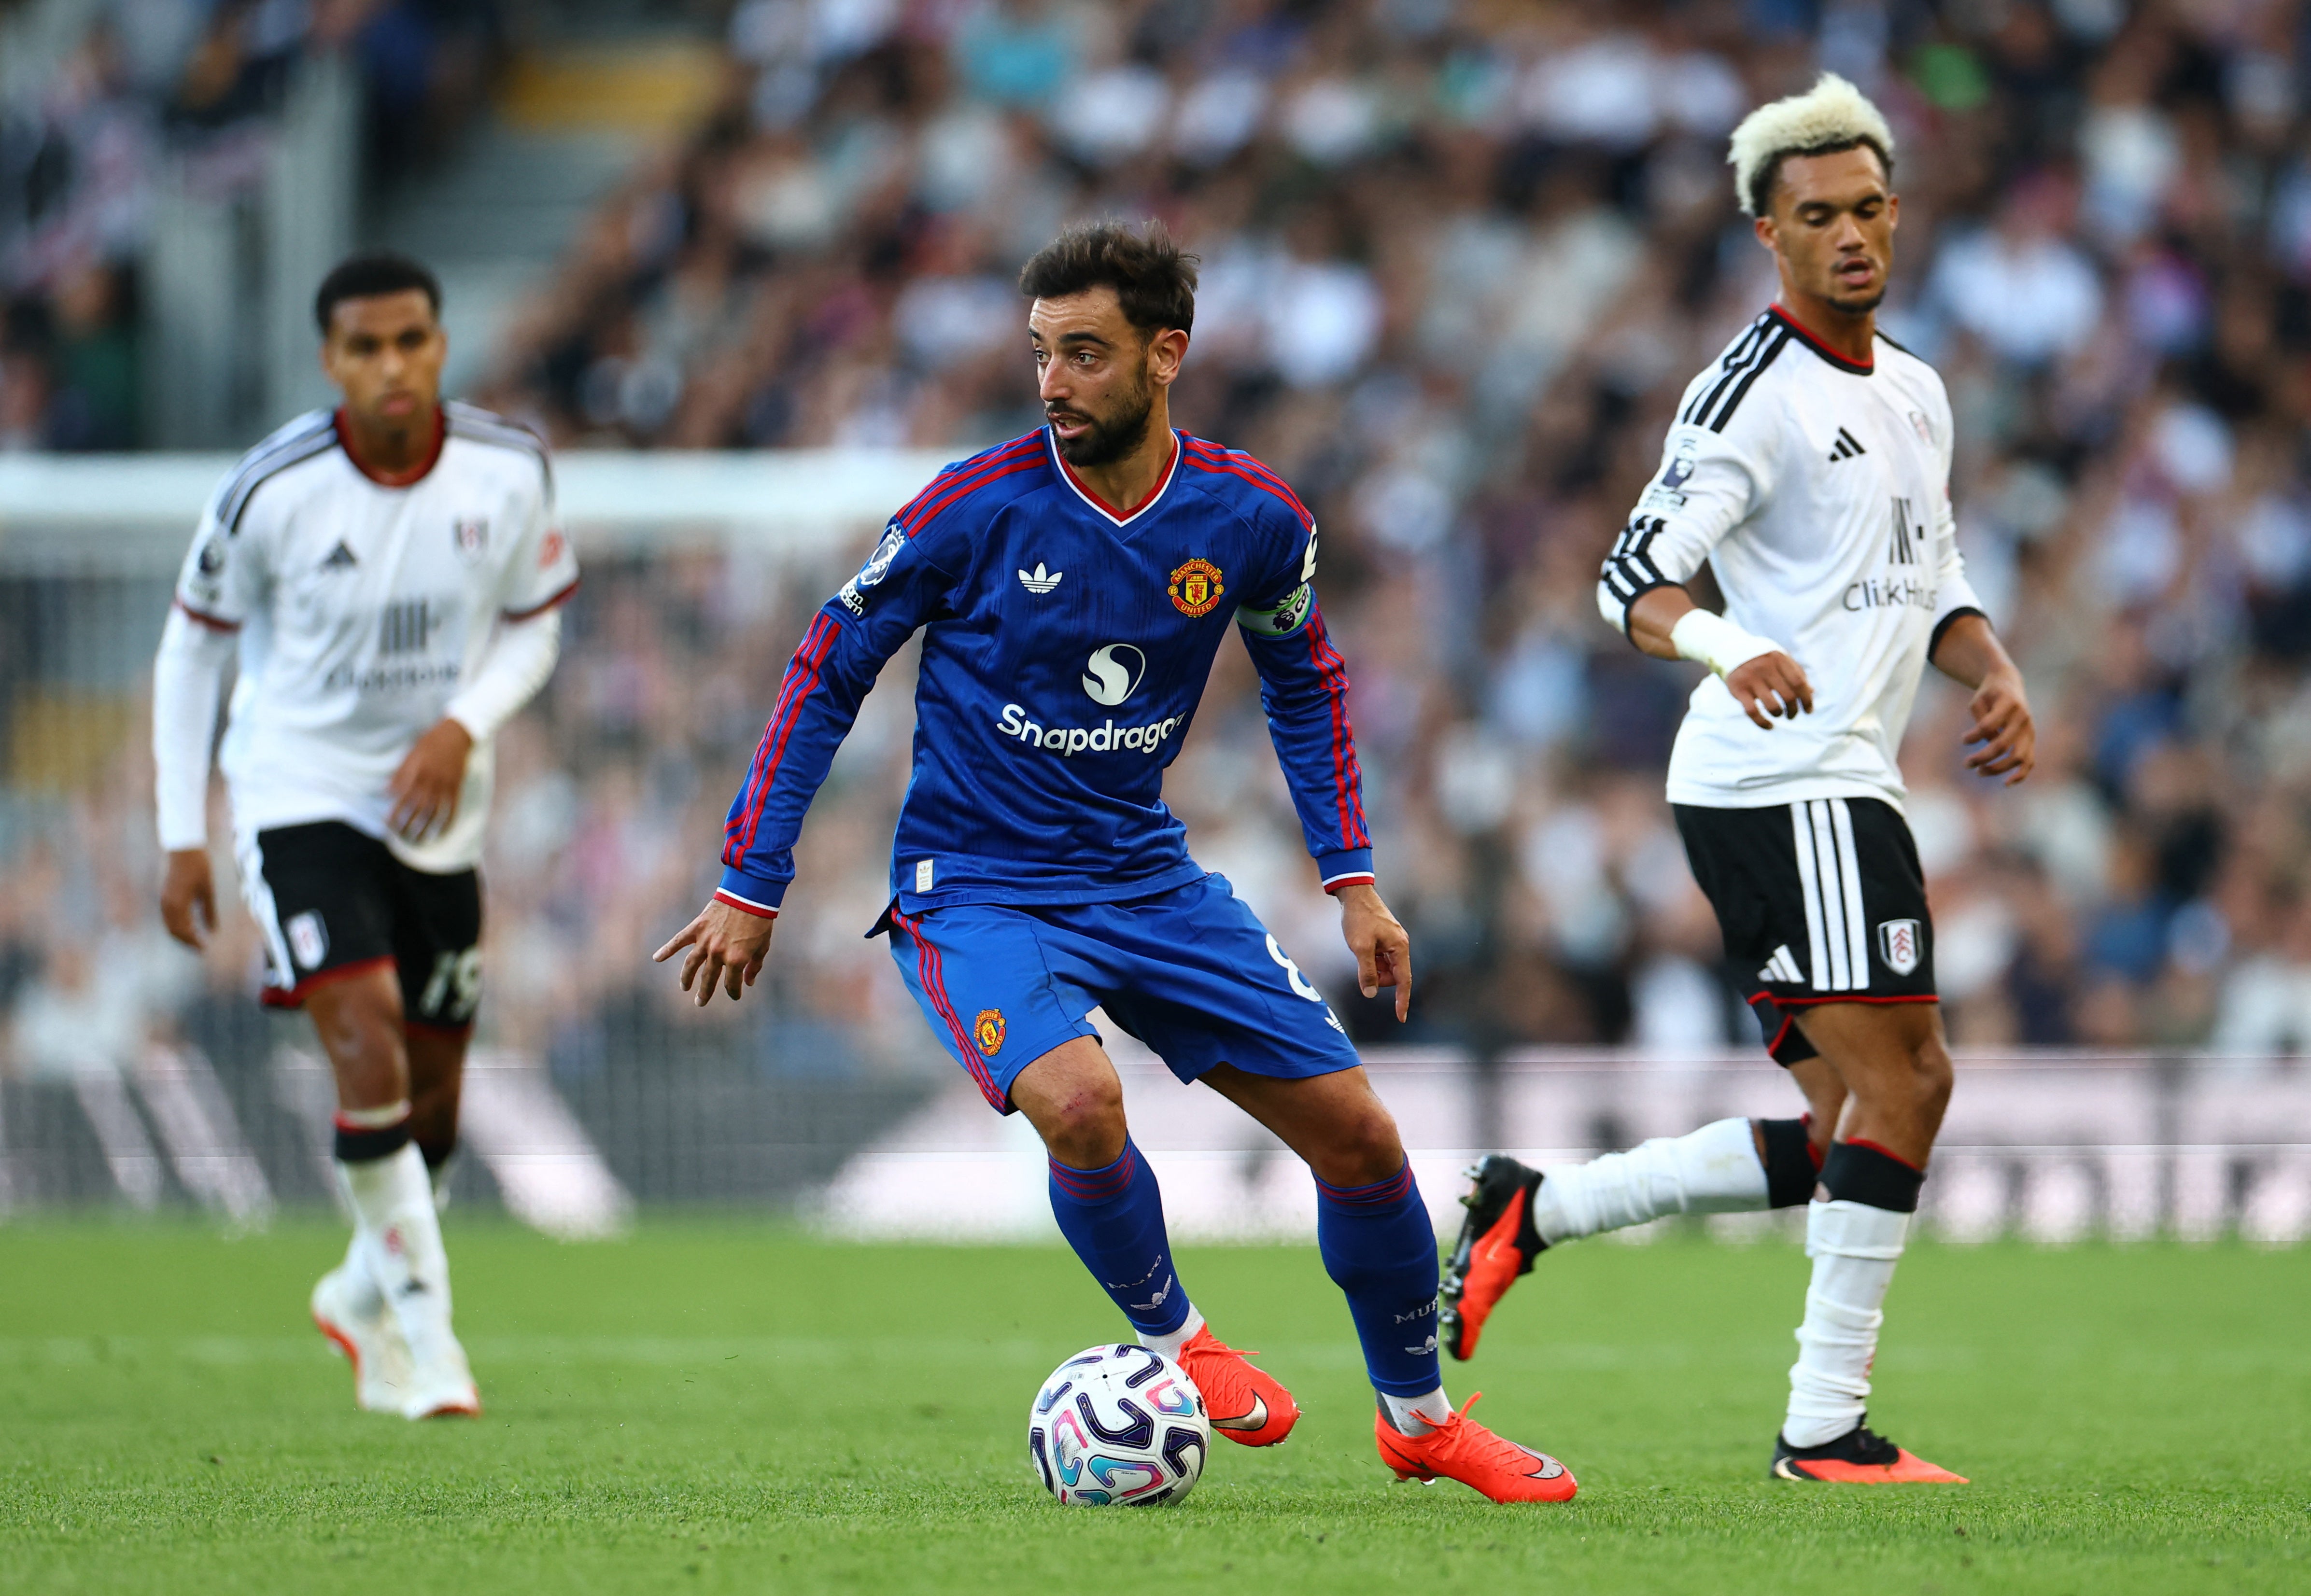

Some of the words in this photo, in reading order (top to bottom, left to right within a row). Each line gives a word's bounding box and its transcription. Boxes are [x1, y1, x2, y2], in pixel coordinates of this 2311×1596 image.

[1174, 562, 1219, 582] MANCHESTER
[1181, 603, 1212, 614] UNITED
[1265, 933, 1322, 1002] 8
[976, 1012, 999, 1039] MANCHESTER
[987, 1036, 1003, 1054] UNITED
